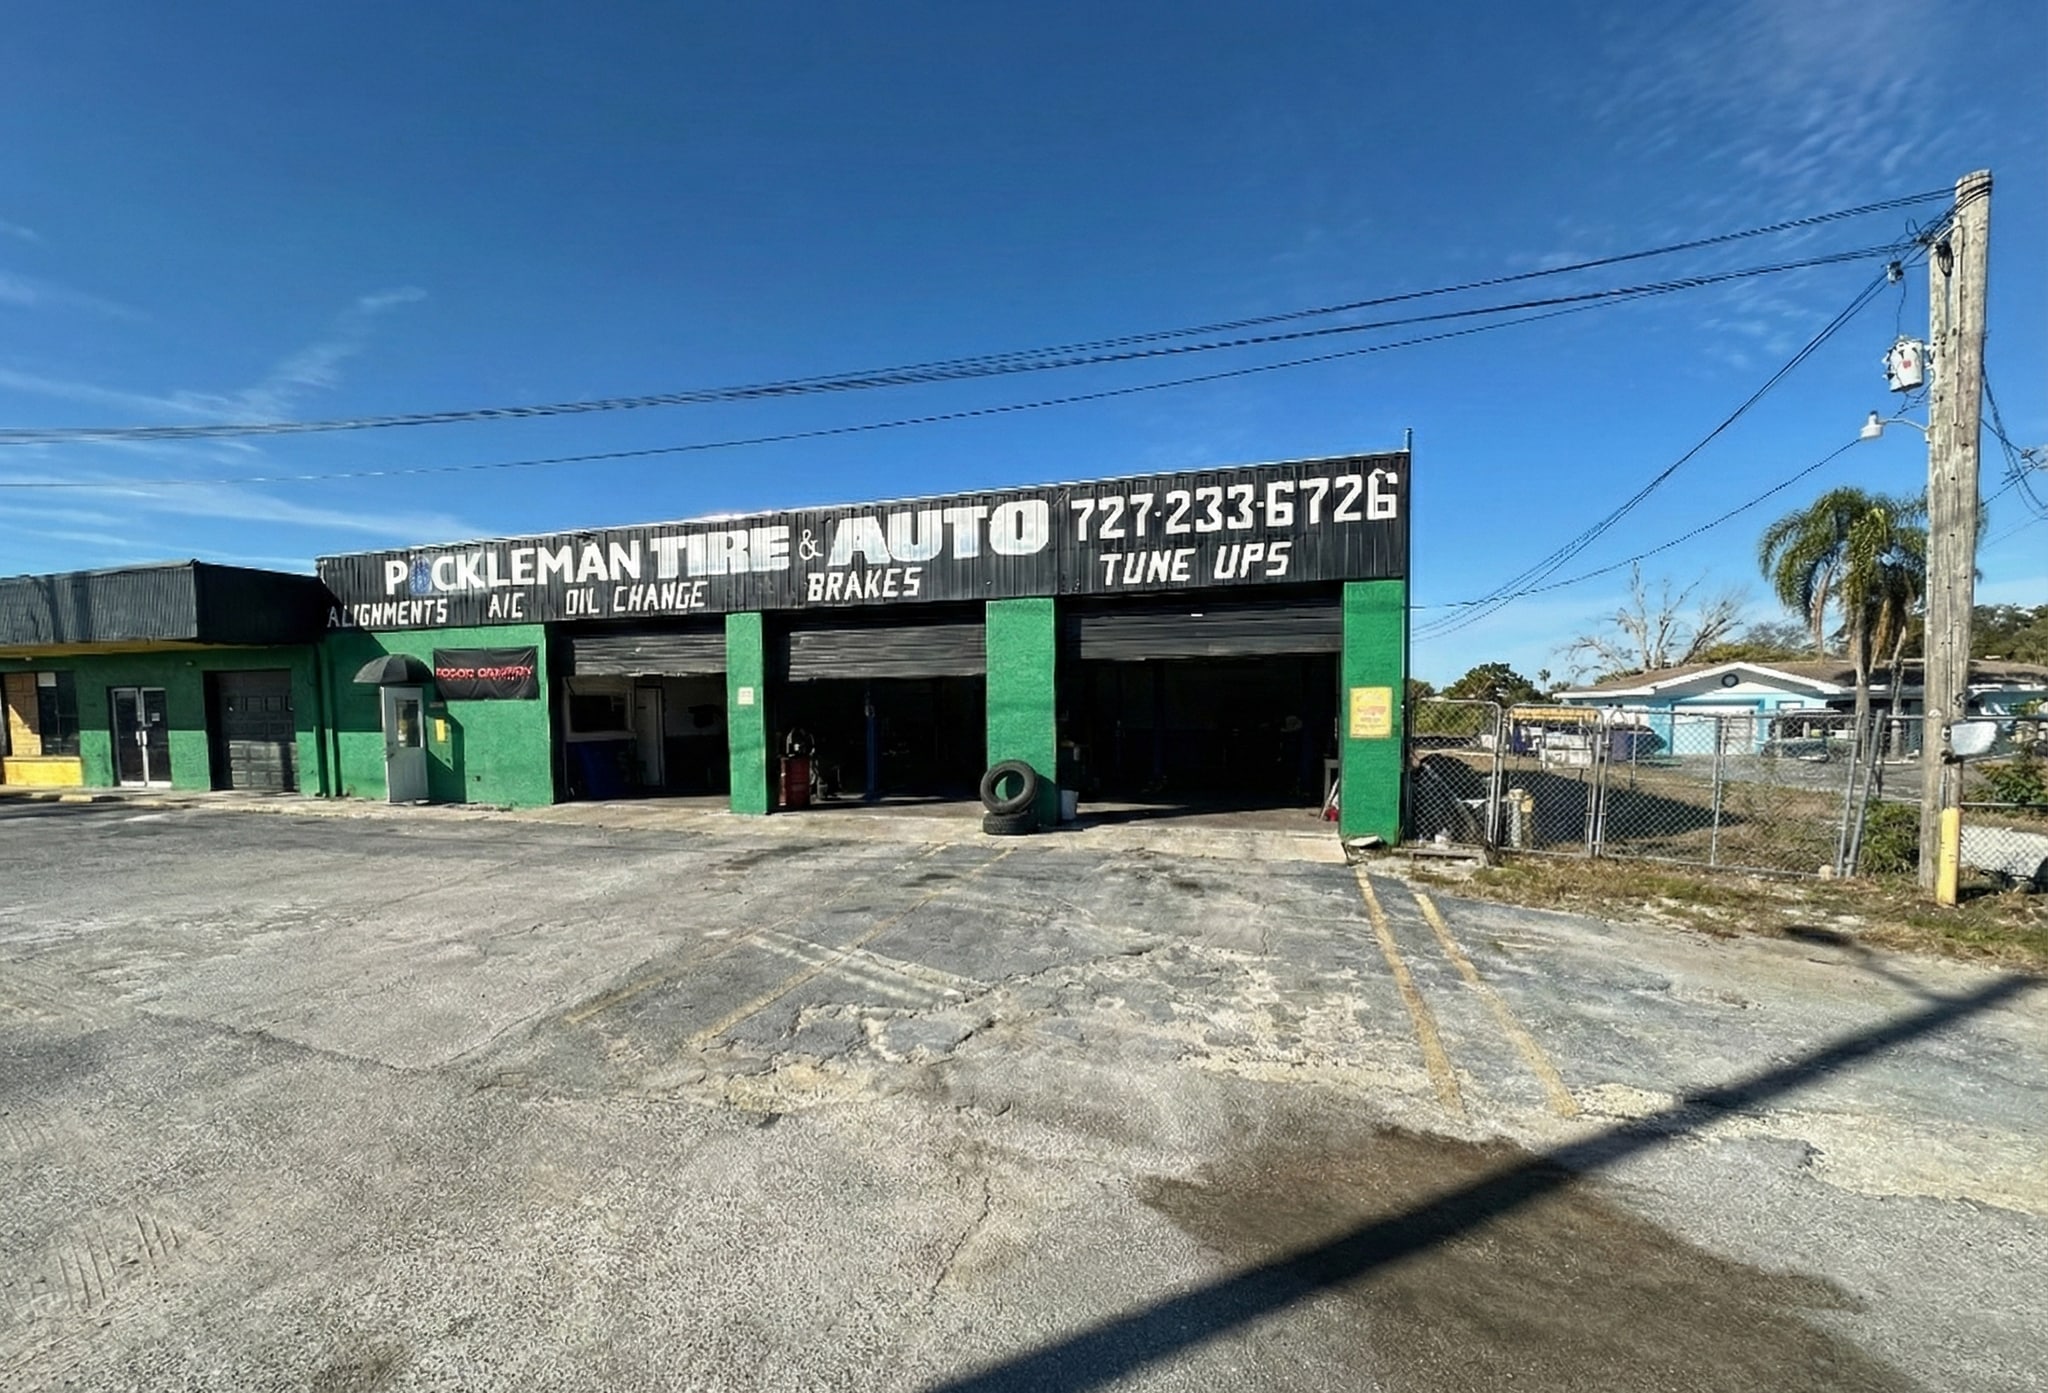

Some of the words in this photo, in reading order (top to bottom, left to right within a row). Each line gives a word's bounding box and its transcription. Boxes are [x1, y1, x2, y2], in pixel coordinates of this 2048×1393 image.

[385, 540, 641, 595] PCKLEMAN
[650, 526, 790, 579] TIRE
[799, 529, 823, 560] &
[827, 500, 1049, 567] AUTO
[1100, 548, 1196, 586] TUNE
[1214, 541, 1292, 579] UPS
[566, 587, 600, 615] OIL
[613, 581, 708, 612] CHANGE
[807, 567, 922, 601] BRAKES
[327, 598, 447, 628] ALIGNMENTS
[488, 592, 525, 618] A/C
